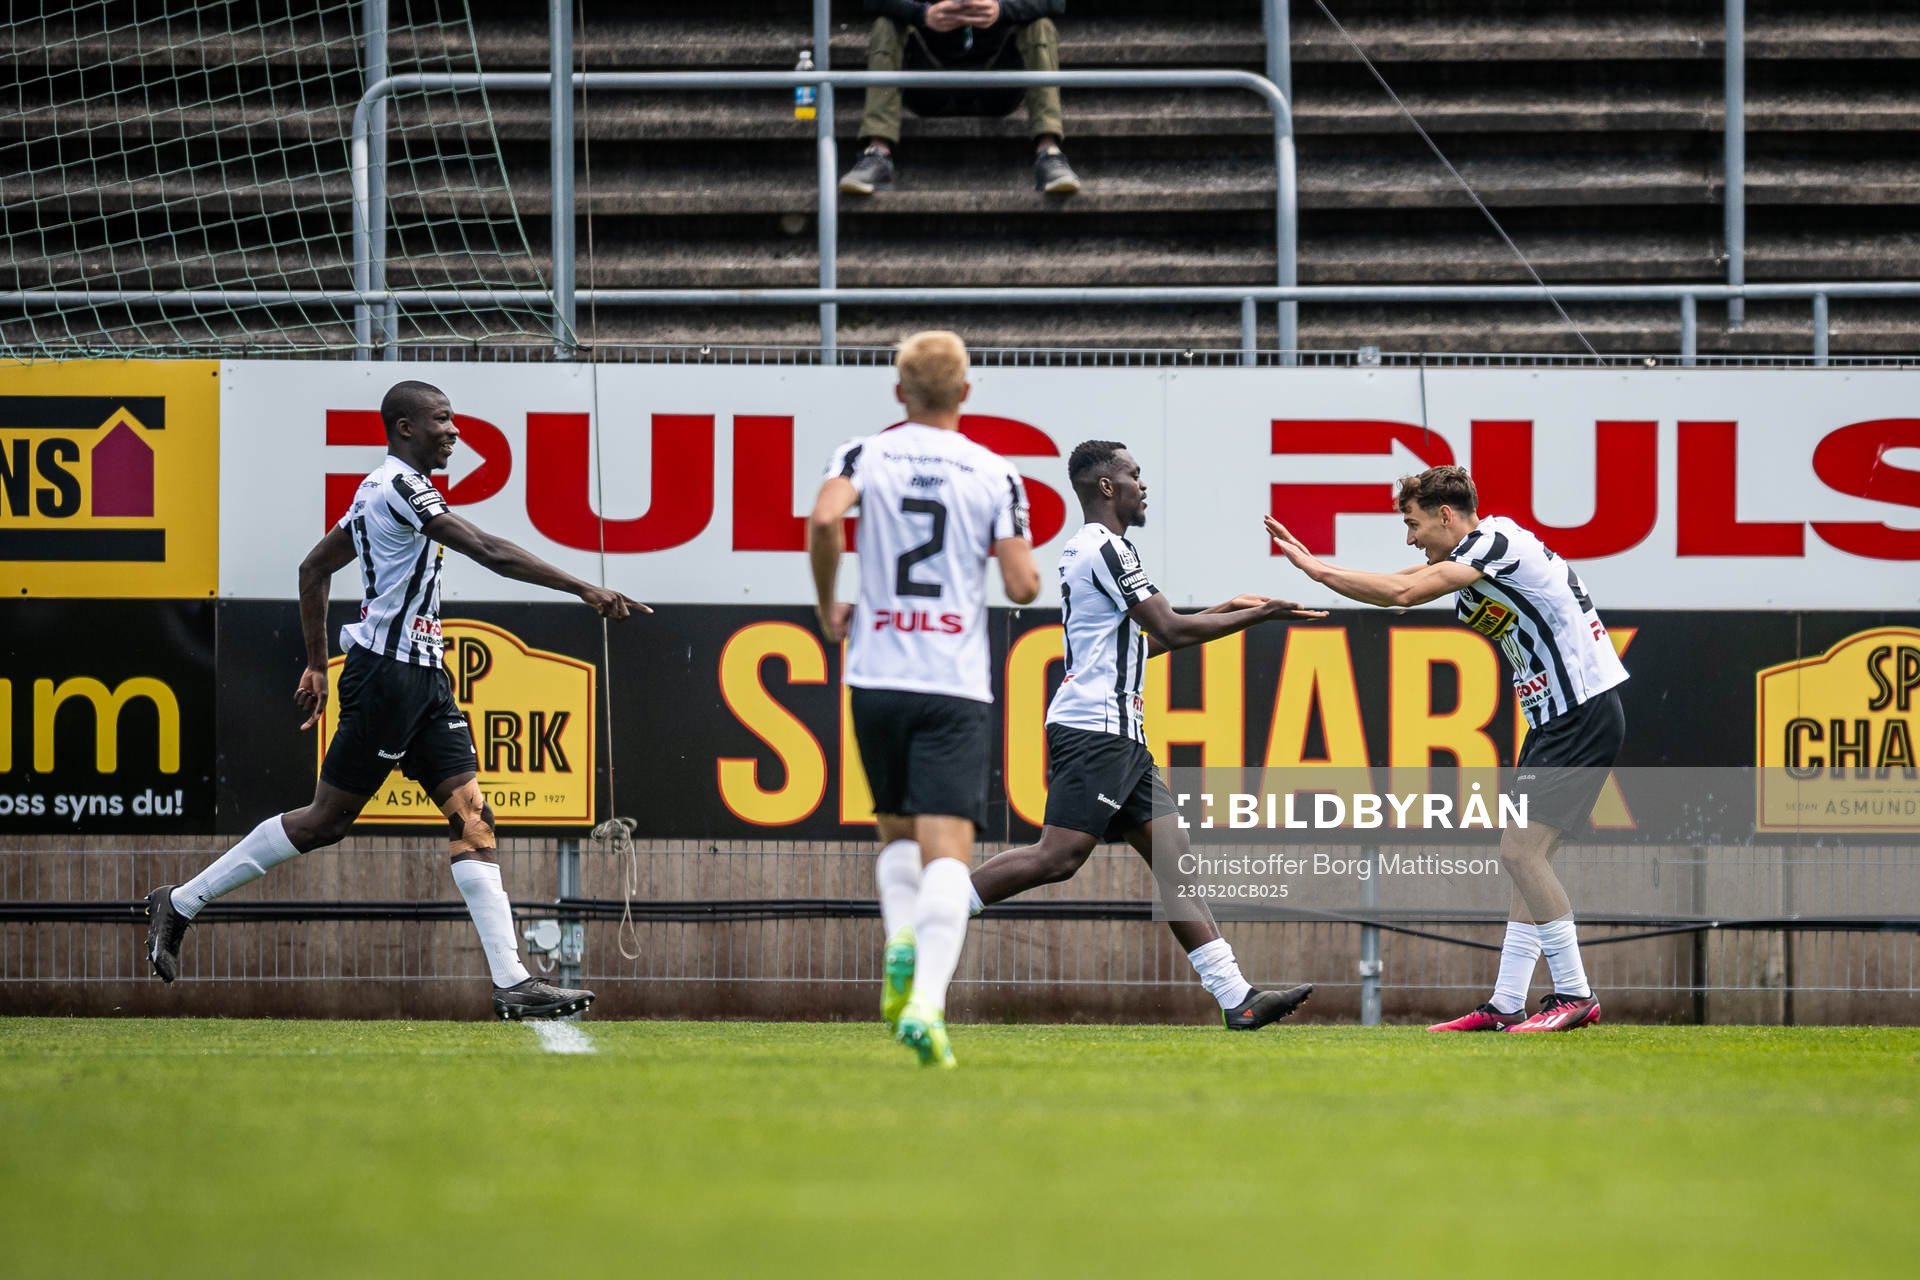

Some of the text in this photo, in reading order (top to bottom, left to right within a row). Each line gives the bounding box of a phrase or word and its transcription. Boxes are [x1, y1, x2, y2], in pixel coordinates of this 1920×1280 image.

[896, 497, 947, 598] 2
[873, 610, 963, 633] PULS
[1784, 718, 1918, 781] CHA
[54, 794, 124, 822] syns
[132, 788, 183, 815] du!
[544, 794, 566, 803] 1927
[1825, 799, 1920, 815] ASMUND
